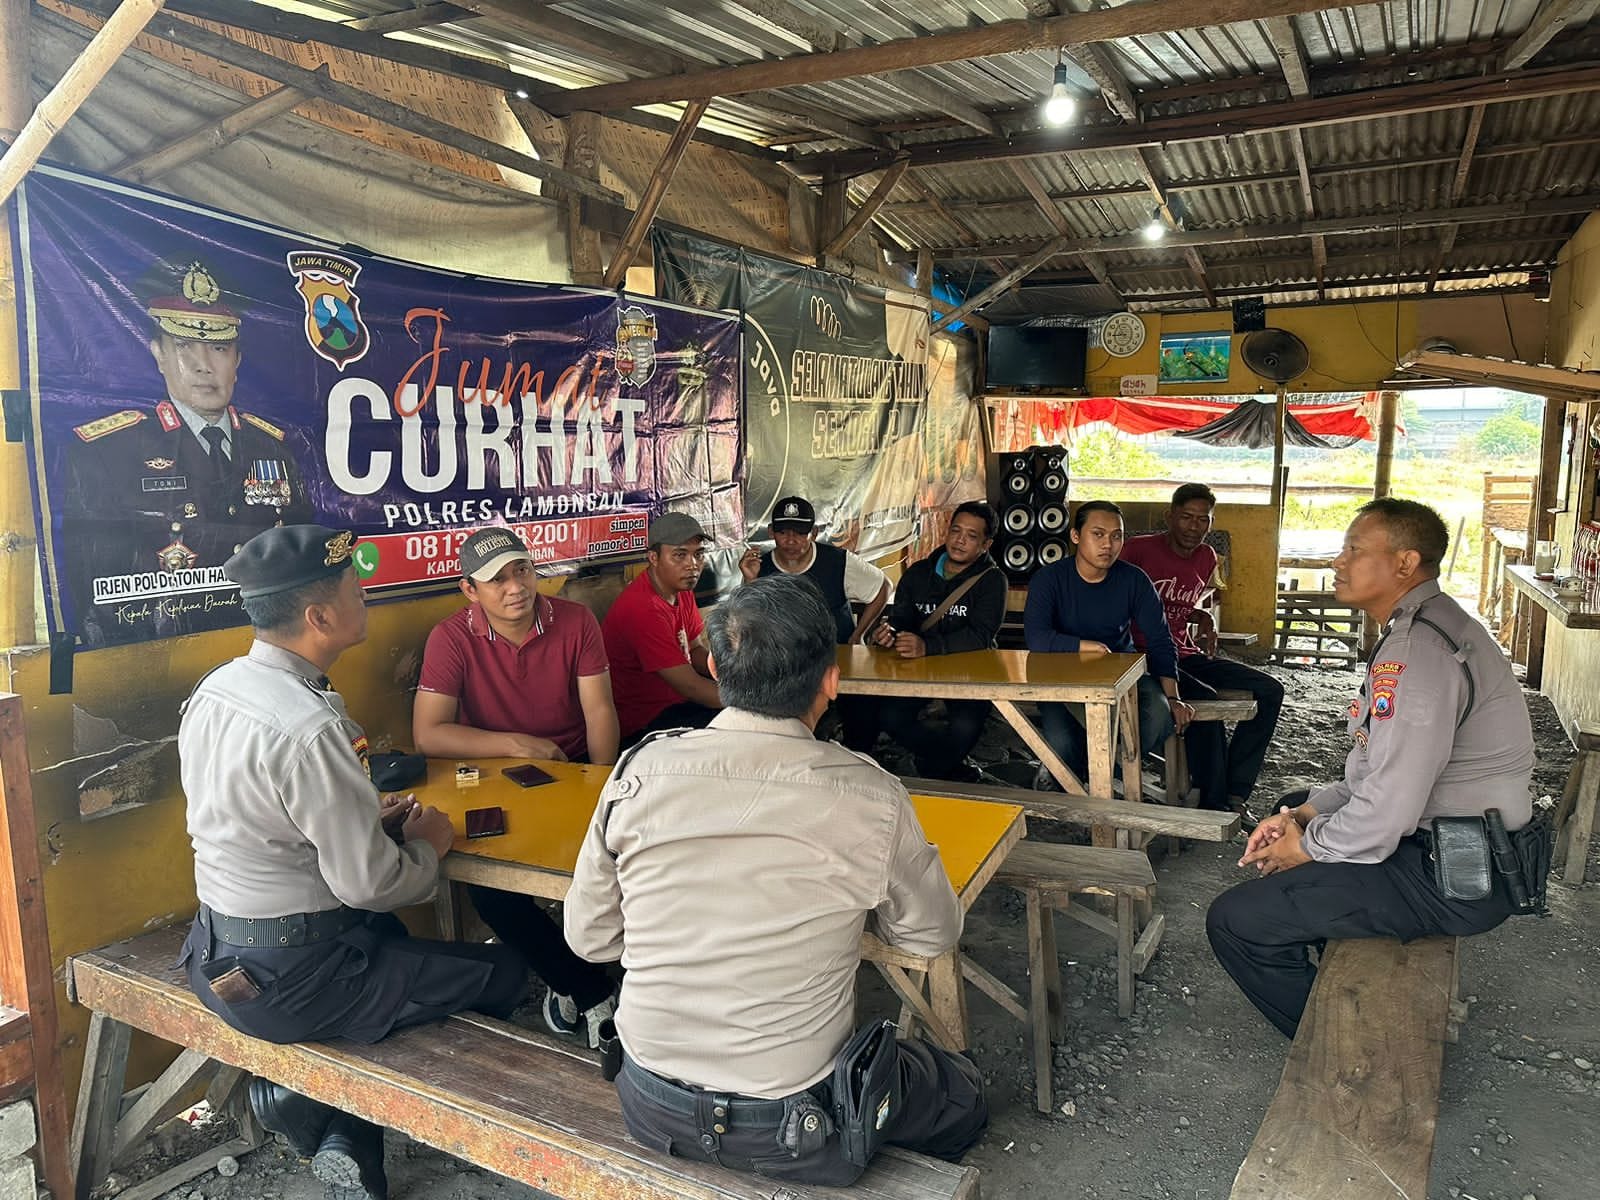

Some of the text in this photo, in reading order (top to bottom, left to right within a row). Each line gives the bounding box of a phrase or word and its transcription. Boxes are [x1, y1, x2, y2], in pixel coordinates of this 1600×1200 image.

[295, 256, 353, 277] JAWA TIMUR
[394, 307, 608, 417] Jumat
[750, 340, 781, 417] Java
[325, 377, 646, 495] CURHAT
[383, 491, 625, 529] POLRES LAMONGAN
[532, 521, 579, 545] 2001
[610, 517, 646, 532] simpen
[588, 534, 645, 553] nomor'e lur
[427, 558, 462, 576] KAPO
[96, 577, 131, 596] IRJEN
[176, 570, 205, 586] TONI
[208, 568, 227, 584] HA
[1153, 577, 1203, 604] Think
[115, 603, 152, 624] Kepala
[204, 593, 238, 613] Daerah
